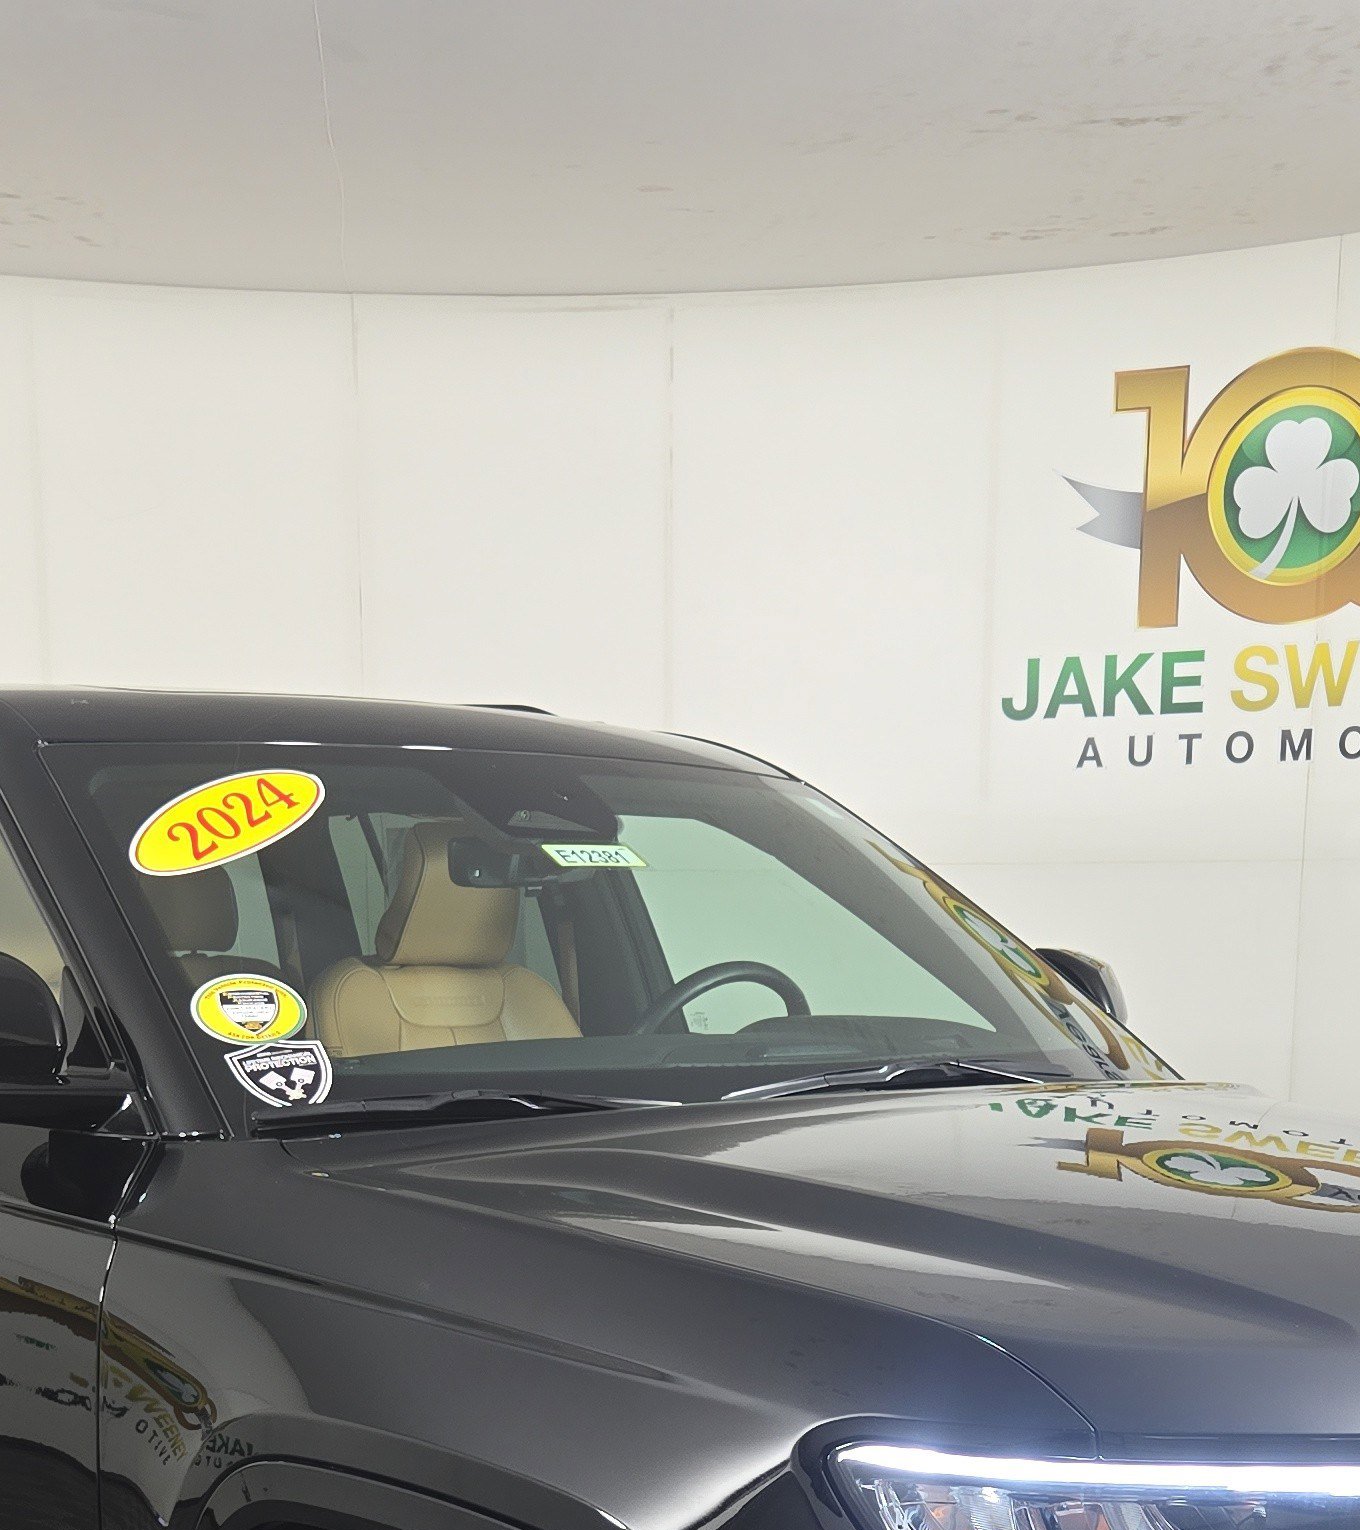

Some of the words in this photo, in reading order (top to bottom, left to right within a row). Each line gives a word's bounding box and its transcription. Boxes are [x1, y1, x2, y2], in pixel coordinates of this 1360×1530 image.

[1001, 649, 1206, 722] JAKE
[166, 777, 299, 861] 2024
[554, 849, 631, 864] E12381
